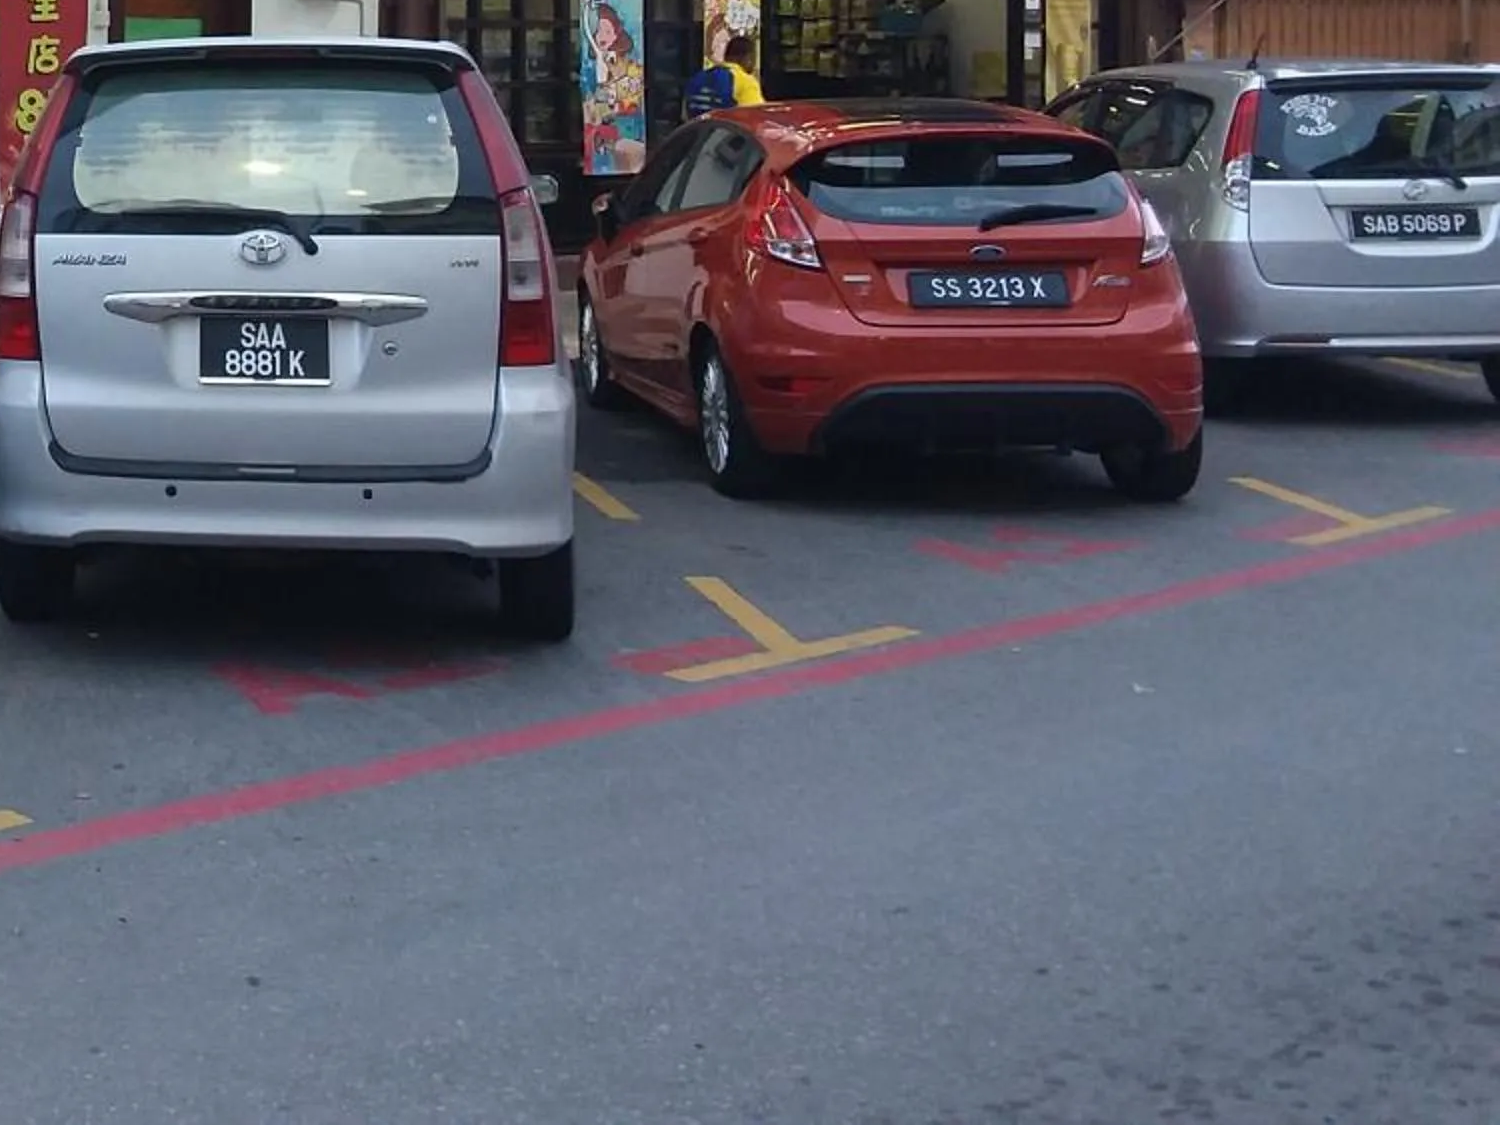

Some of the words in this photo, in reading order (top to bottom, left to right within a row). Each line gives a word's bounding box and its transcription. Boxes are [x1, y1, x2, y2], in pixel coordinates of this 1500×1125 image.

[1363, 214, 1400, 233] SAB
[1402, 214, 1451, 232] 5069
[1453, 214, 1466, 232] P
[931, 276, 962, 298] SS
[969, 276, 1025, 298] 3213
[1031, 277, 1046, 298] X
[240, 322, 287, 349] SAA
[225, 349, 281, 376] 8881
[289, 349, 305, 376] K
